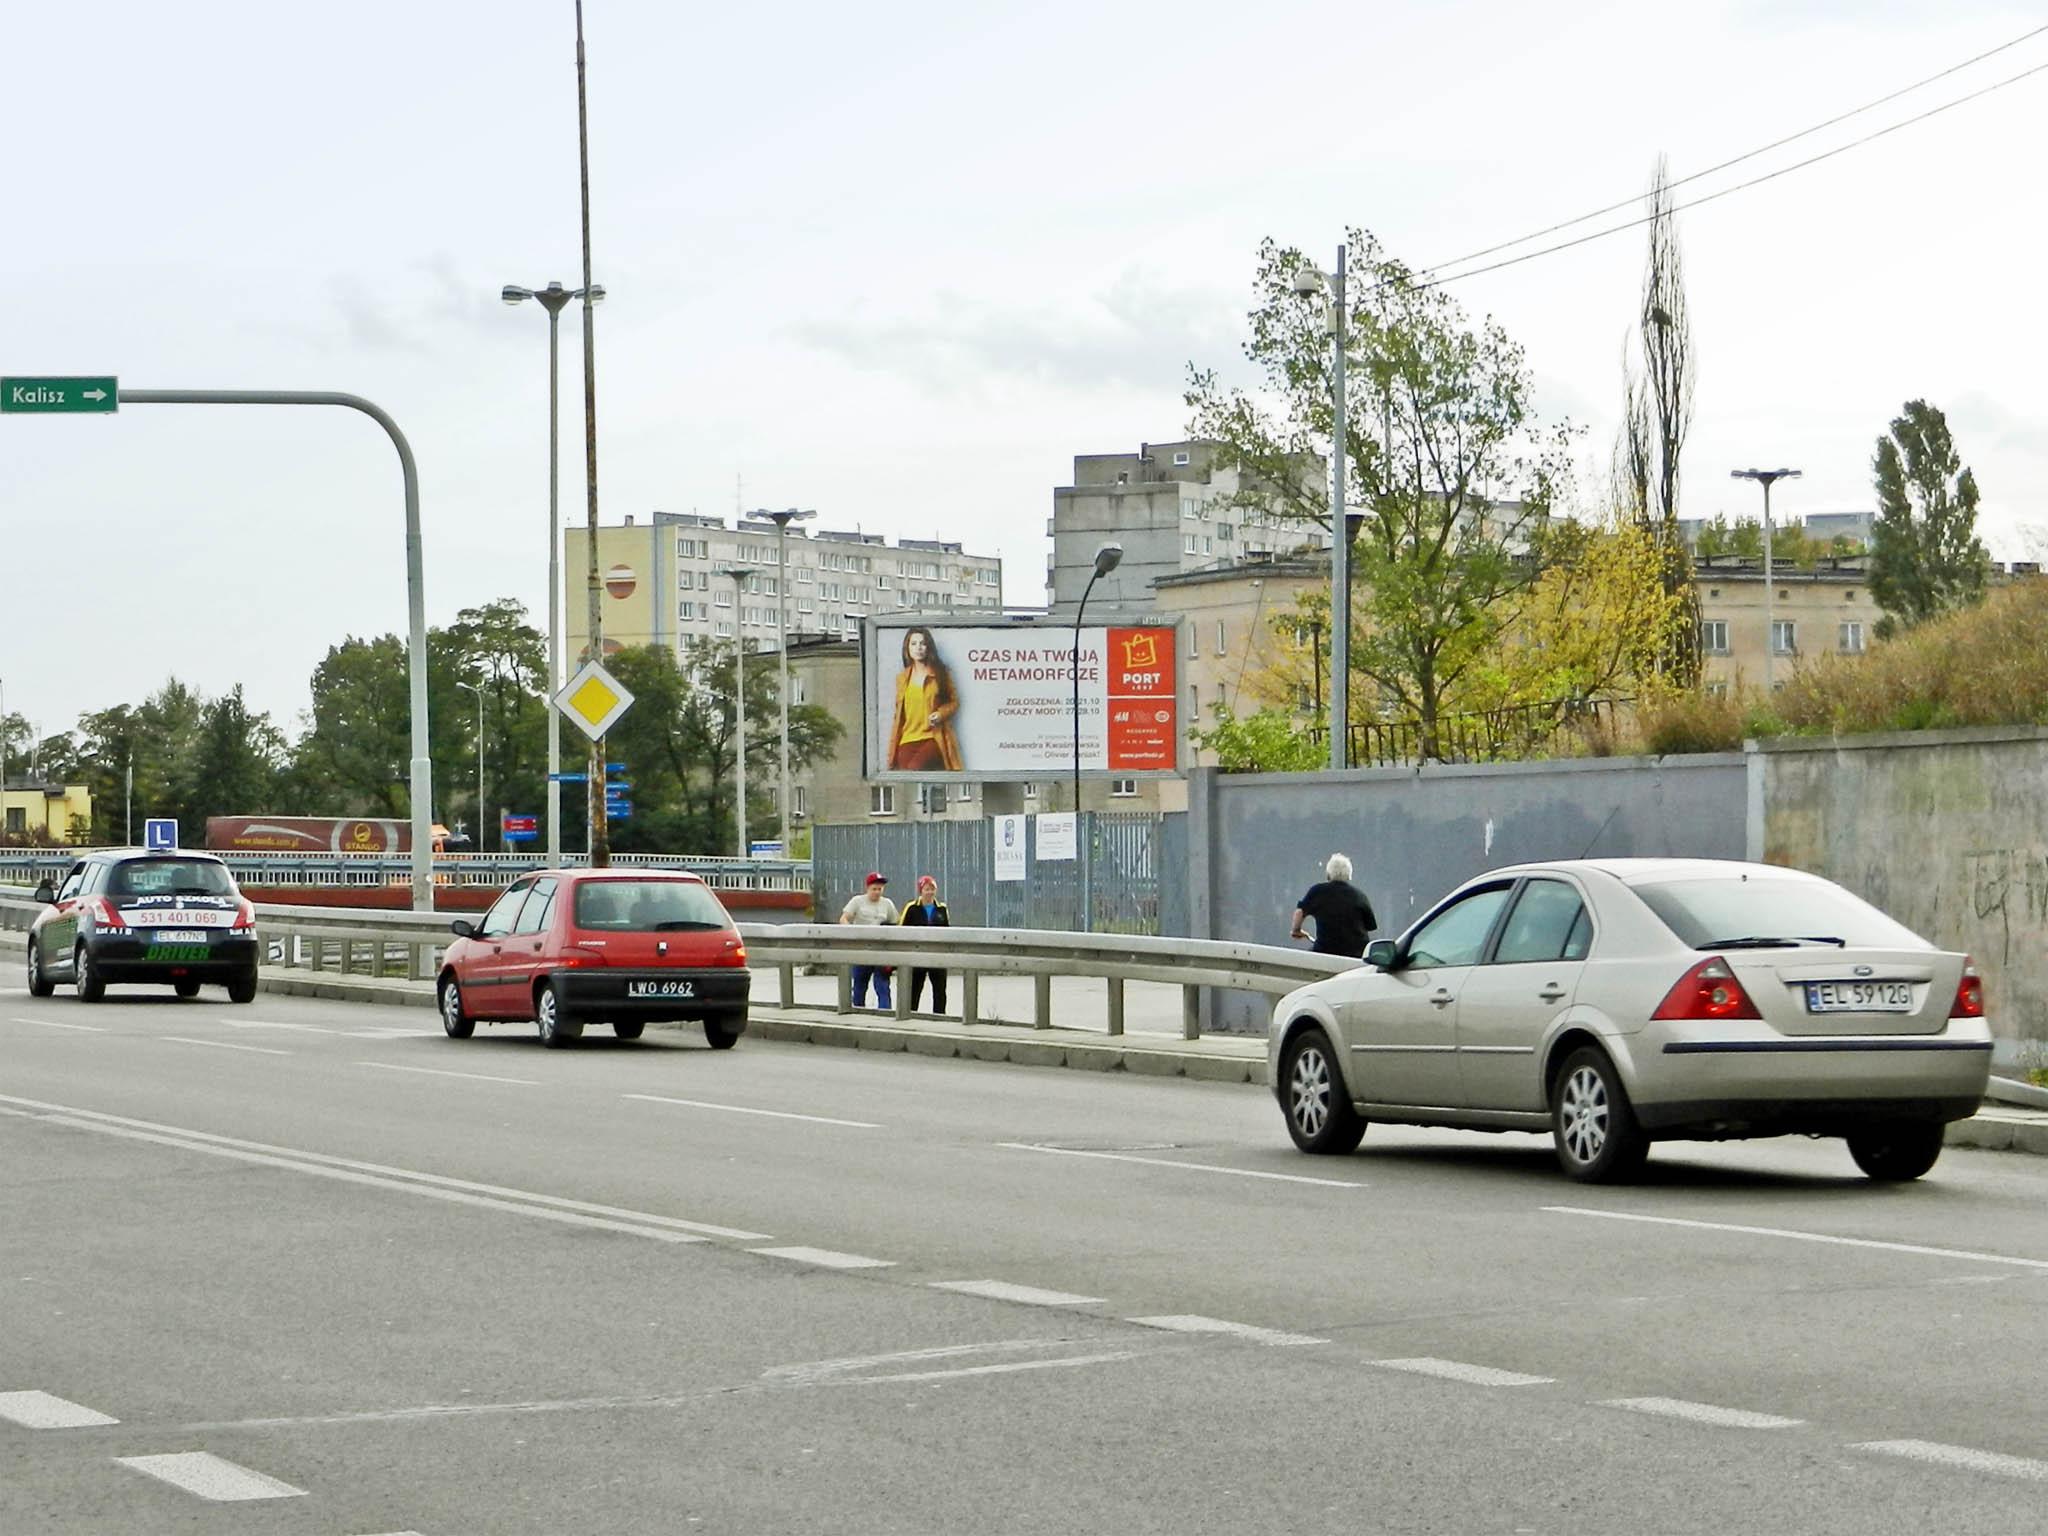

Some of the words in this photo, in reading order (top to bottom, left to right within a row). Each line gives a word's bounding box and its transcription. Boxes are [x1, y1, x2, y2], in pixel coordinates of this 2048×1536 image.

[12, 386, 65, 404] Kalisz
[968, 650, 1012, 663] CZAS
[1016, 650, 1038, 663] NA
[1044, 650, 1099, 665] TWOJĄ
[974, 668, 1099, 684] METAMORFOZĘ
[1122, 673, 1161, 684] PORT
[1065, 697, 1100, 706] 2021.10
[156, 824, 171, 845] L
[136, 895, 172, 905] AUTO
[141, 912, 163, 923] 531
[168, 912, 190, 923] 401
[195, 912, 217, 923] 069
[146, 944, 210, 961] DRIVER
[628, 981, 657, 994] LWO
[662, 981, 693, 994] 6962
[1820, 984, 1847, 1004] EL
[1853, 984, 1909, 1004] 5912G
